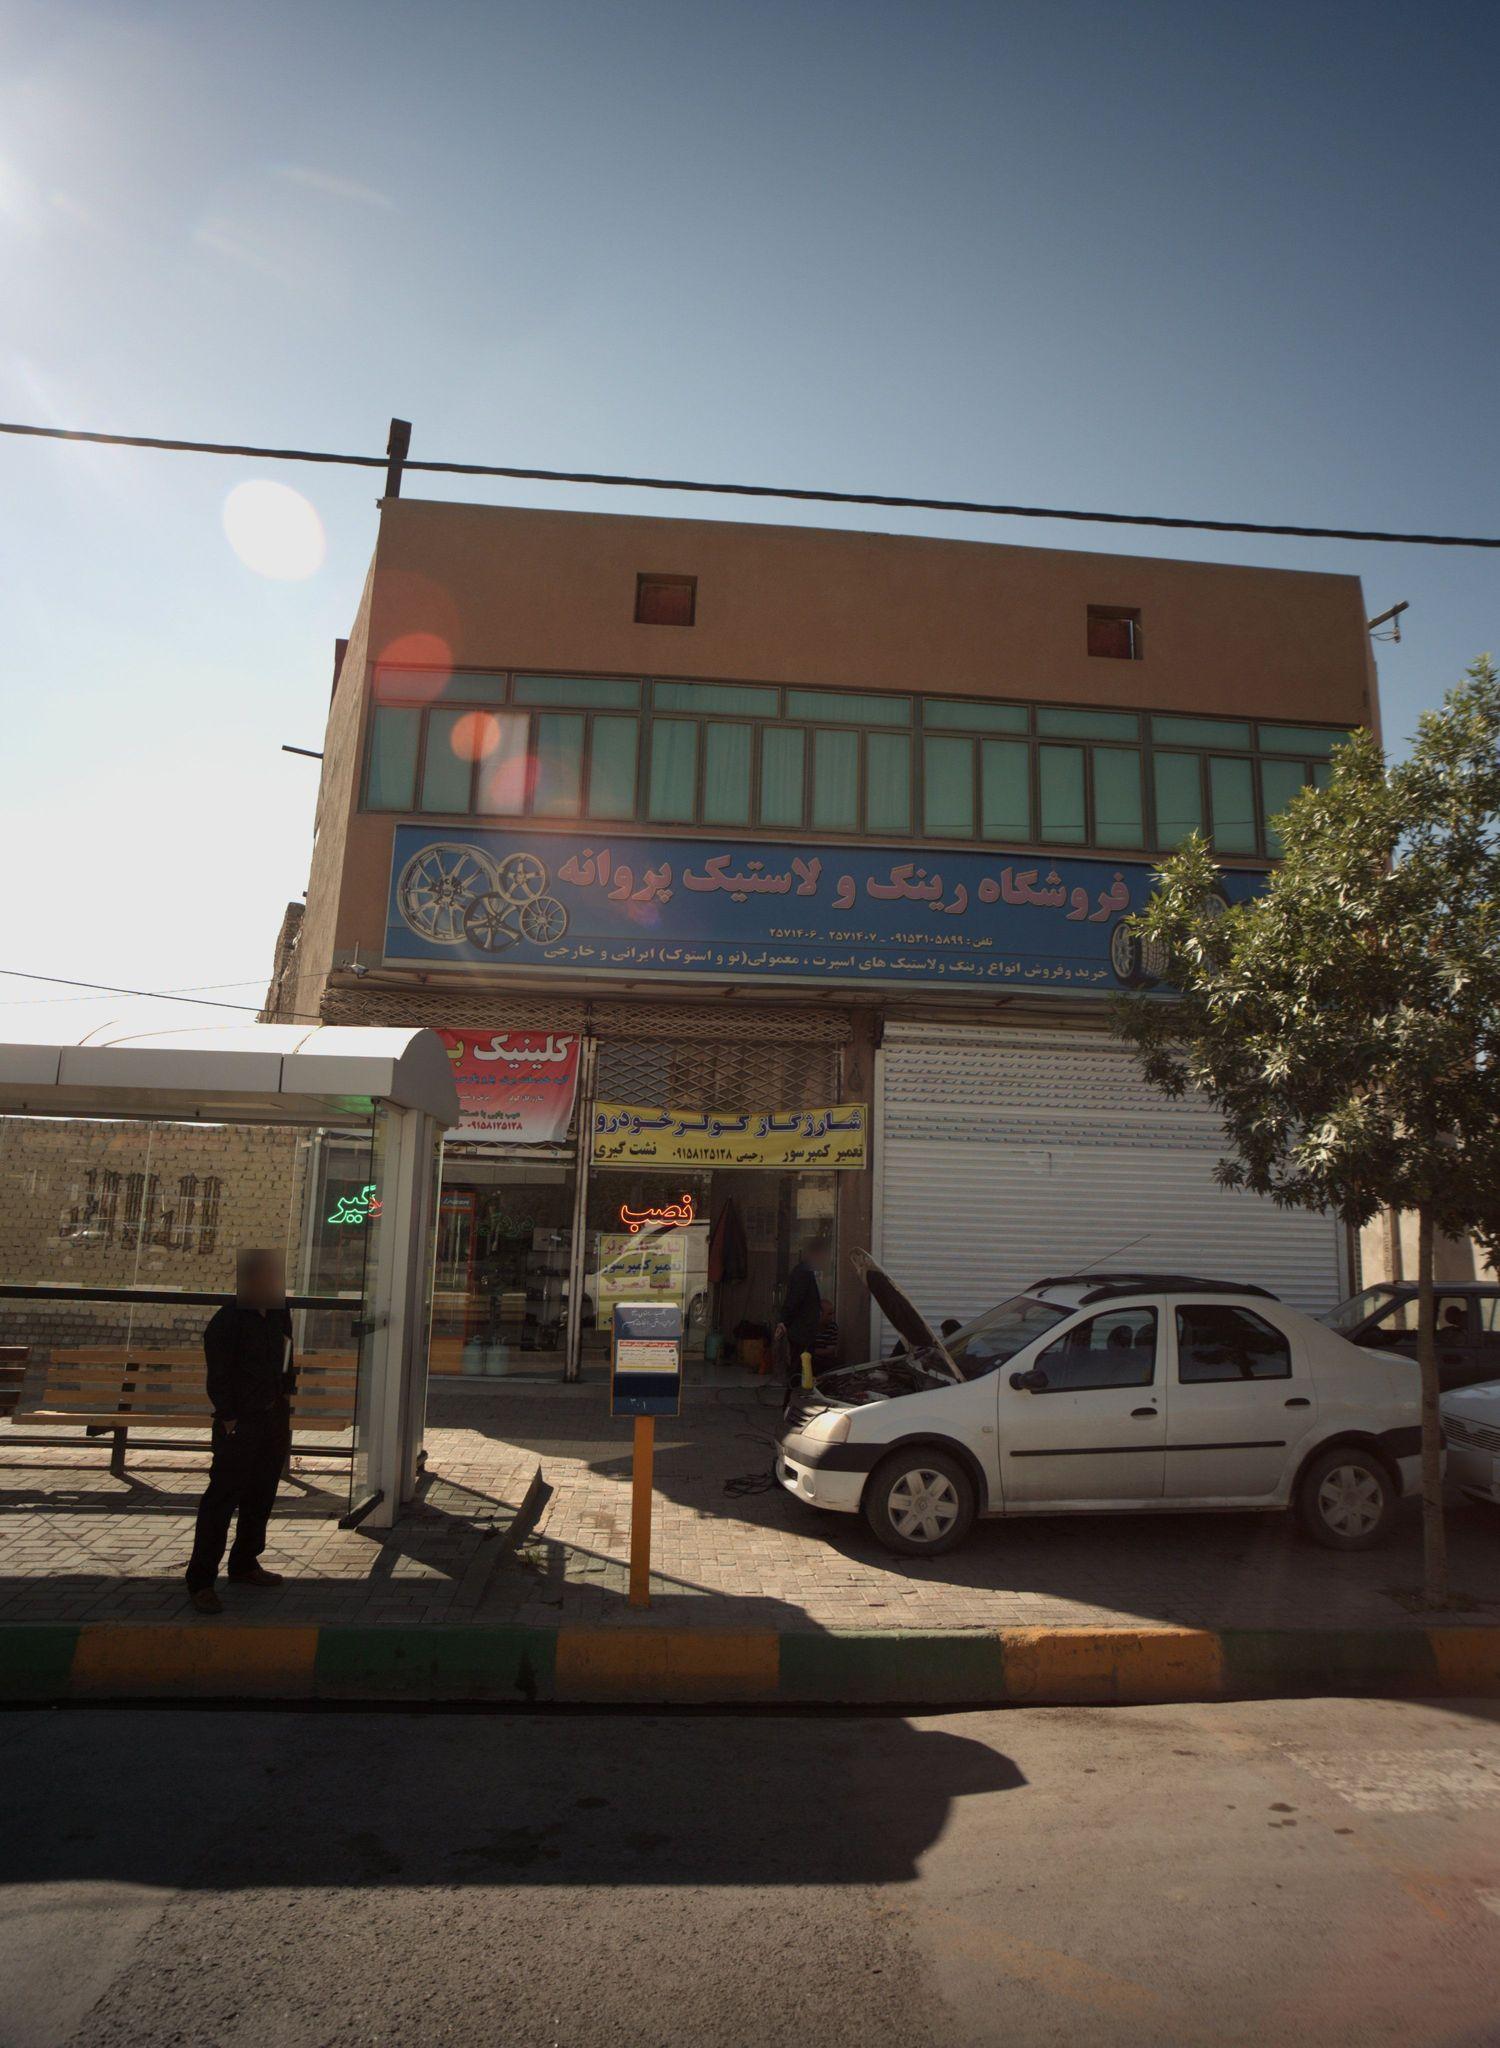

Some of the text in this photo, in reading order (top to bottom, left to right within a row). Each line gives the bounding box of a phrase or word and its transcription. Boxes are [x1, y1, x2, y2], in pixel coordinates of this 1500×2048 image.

[558, 847, 1130, 923] فروشگاه رینگ و لاستیک پروانه
[543, 944, 596, 961] خارجی
[599, 949, 608, 961] و
[611, 945, 656, 963] ایرانی
[715, 954, 724, 966] و
[858, 956, 887, 971] های
[988, 961, 1021, 977] انواع
[1074, 967, 1109, 982] خرید
[473, 1033, 575, 1070] کلینیک
[593, 1108, 864, 1139] شارژ گاز کولر خودرو
[628, 1141, 658, 1156] نشت
[834, 1143, 864, 1163] تعمیر
[620, 1194, 693, 1233] نصب
